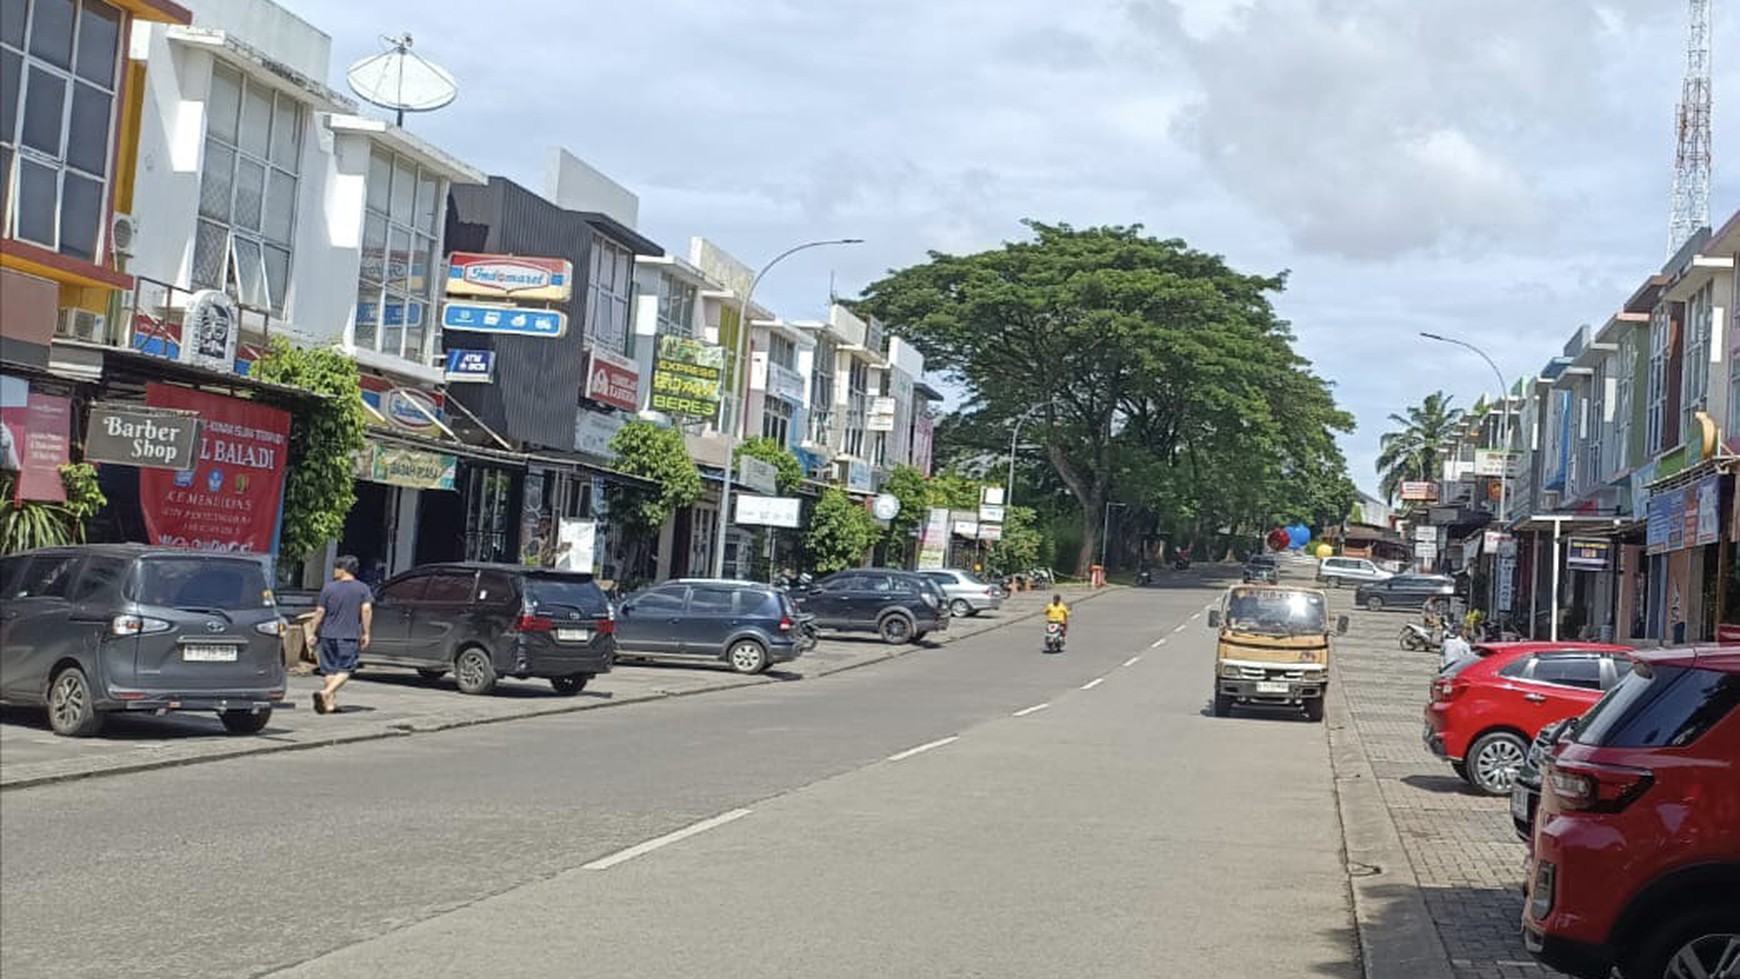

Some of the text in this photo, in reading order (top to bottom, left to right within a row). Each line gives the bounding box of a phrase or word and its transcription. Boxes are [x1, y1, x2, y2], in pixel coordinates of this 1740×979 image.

[469, 266, 544, 284] Indomaret
[463, 353, 483, 363] ATM
[103, 416, 181, 442] Barber
[130, 438, 178, 464] Shop
[213, 440, 275, 470] BALADI
